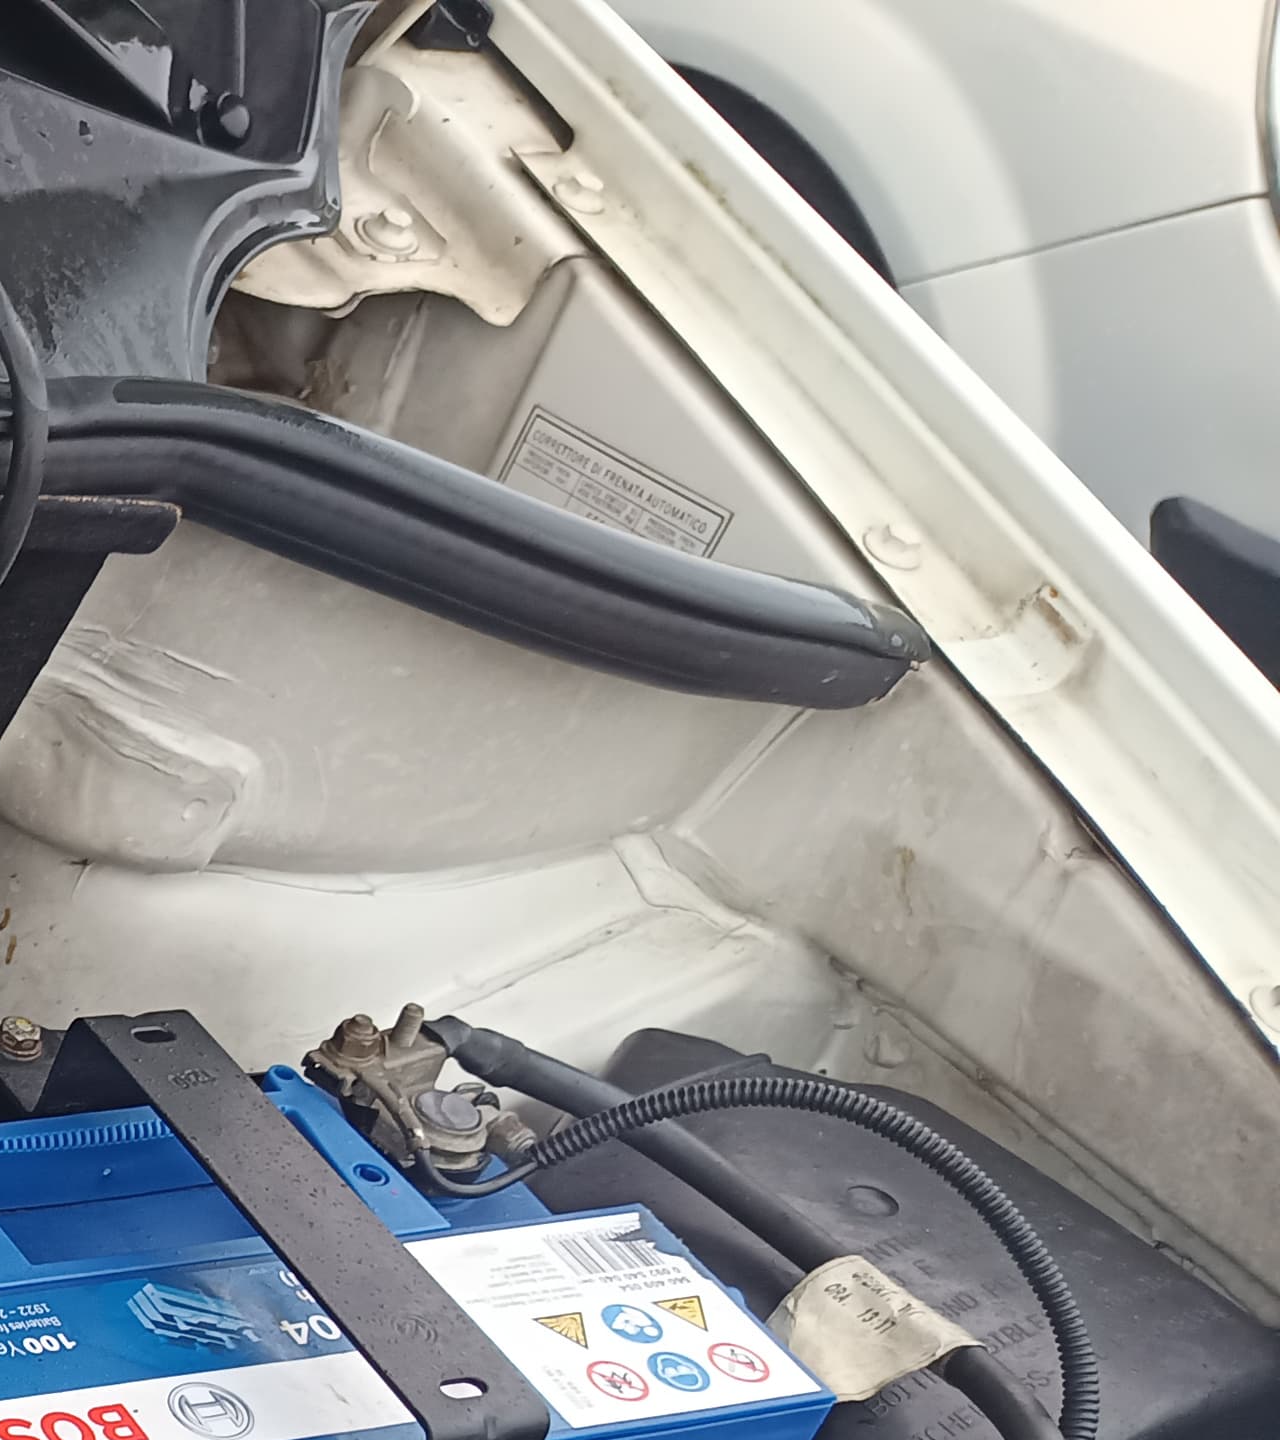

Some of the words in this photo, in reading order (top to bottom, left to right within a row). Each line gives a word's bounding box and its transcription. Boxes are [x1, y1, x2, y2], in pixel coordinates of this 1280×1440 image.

[532, 429, 591, 469] CORRETTORE
[590, 460, 603, 475] DI
[603, 465, 645, 499] FRENATA
[645, 489, 708, 534] AUTOMATICO
[17, 1302, 51, 1315] 1922
[8, 1315, 62, 1332] Batteries
